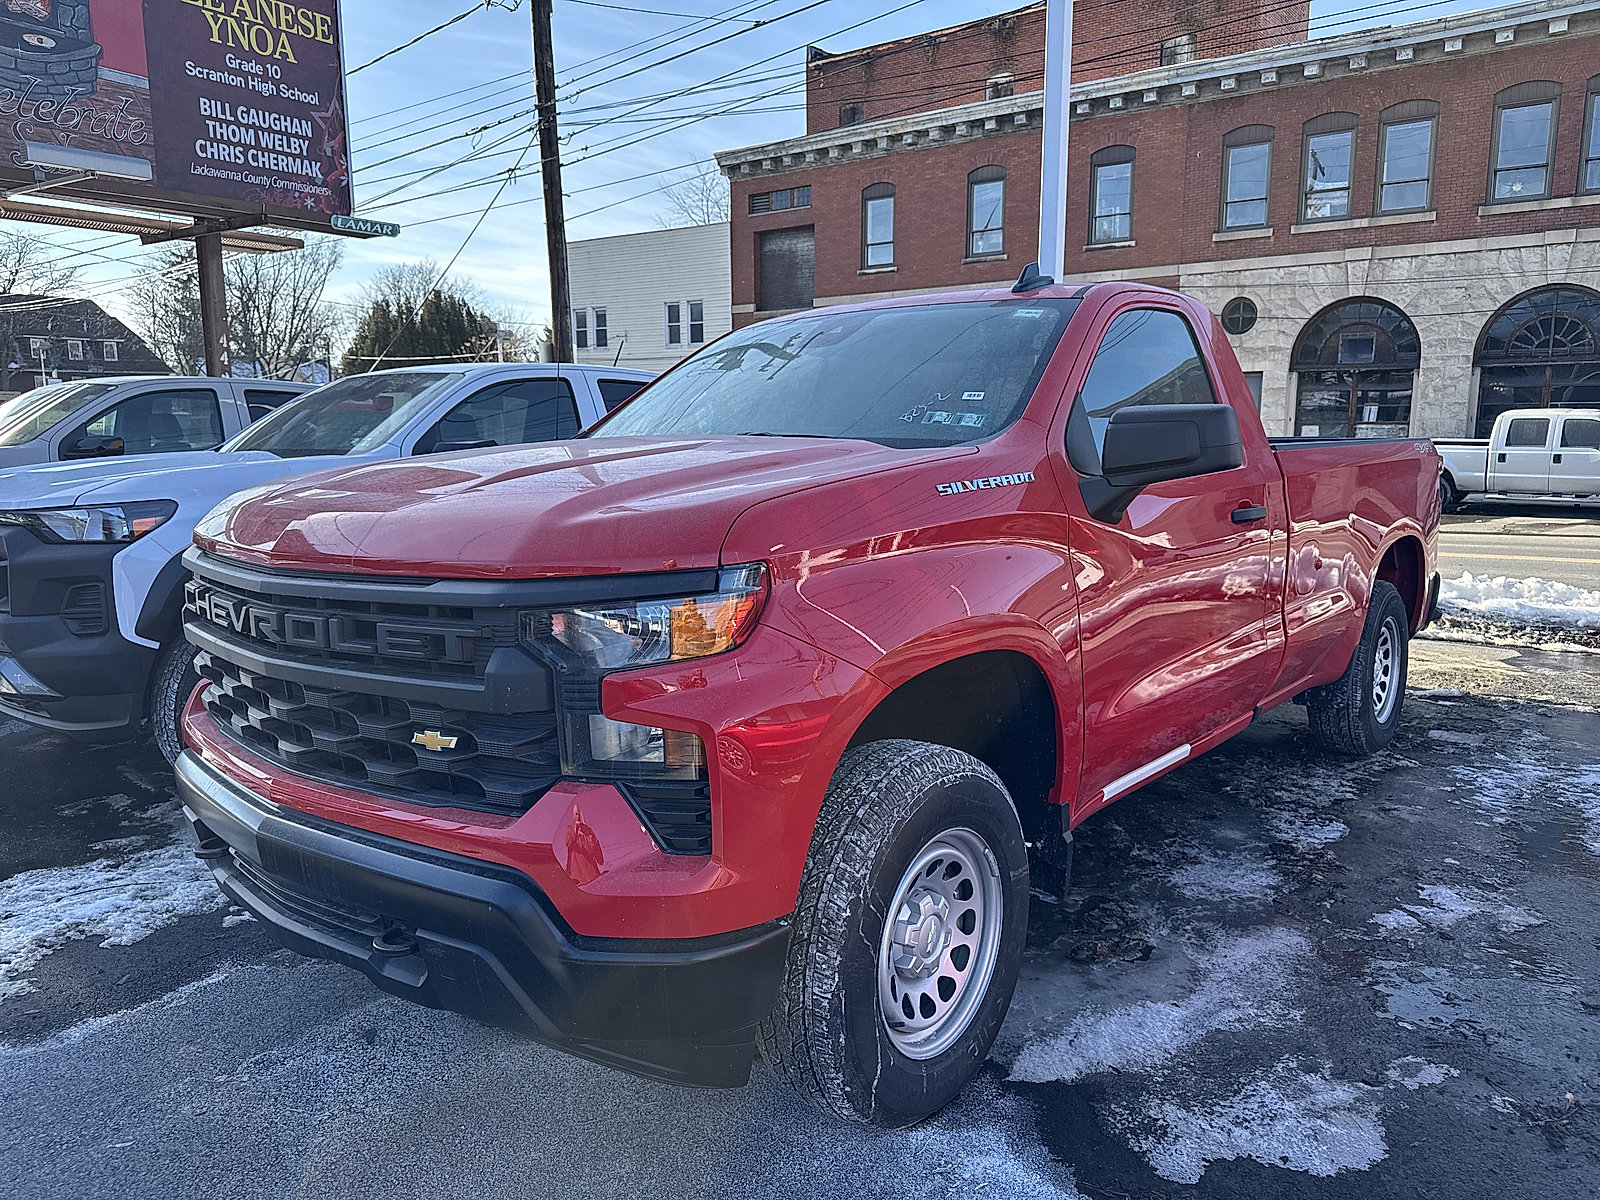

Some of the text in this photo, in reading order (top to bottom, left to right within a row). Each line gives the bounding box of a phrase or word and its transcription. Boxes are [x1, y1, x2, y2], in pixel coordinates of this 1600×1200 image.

[201, 9, 298, 64] YNOA
[231, 0, 334, 45] ANESE
[185, 60, 320, 105] Scranton High School
[225, 53, 281, 79] Grade 10
[0, 74, 147, 145] elebrate
[199, 97, 313, 137] BILL GAUGHAN
[205, 119, 310, 157] THOM WELBY
[194, 139, 323, 178] CHRIS CHERMAK
[190, 162, 330, 196] Lackawanna County Commissioners
[336, 217, 393, 235] LAMAR
[936, 471, 1036, 496] SILVERADO
[184, 578, 491, 663] CHEVROLET
